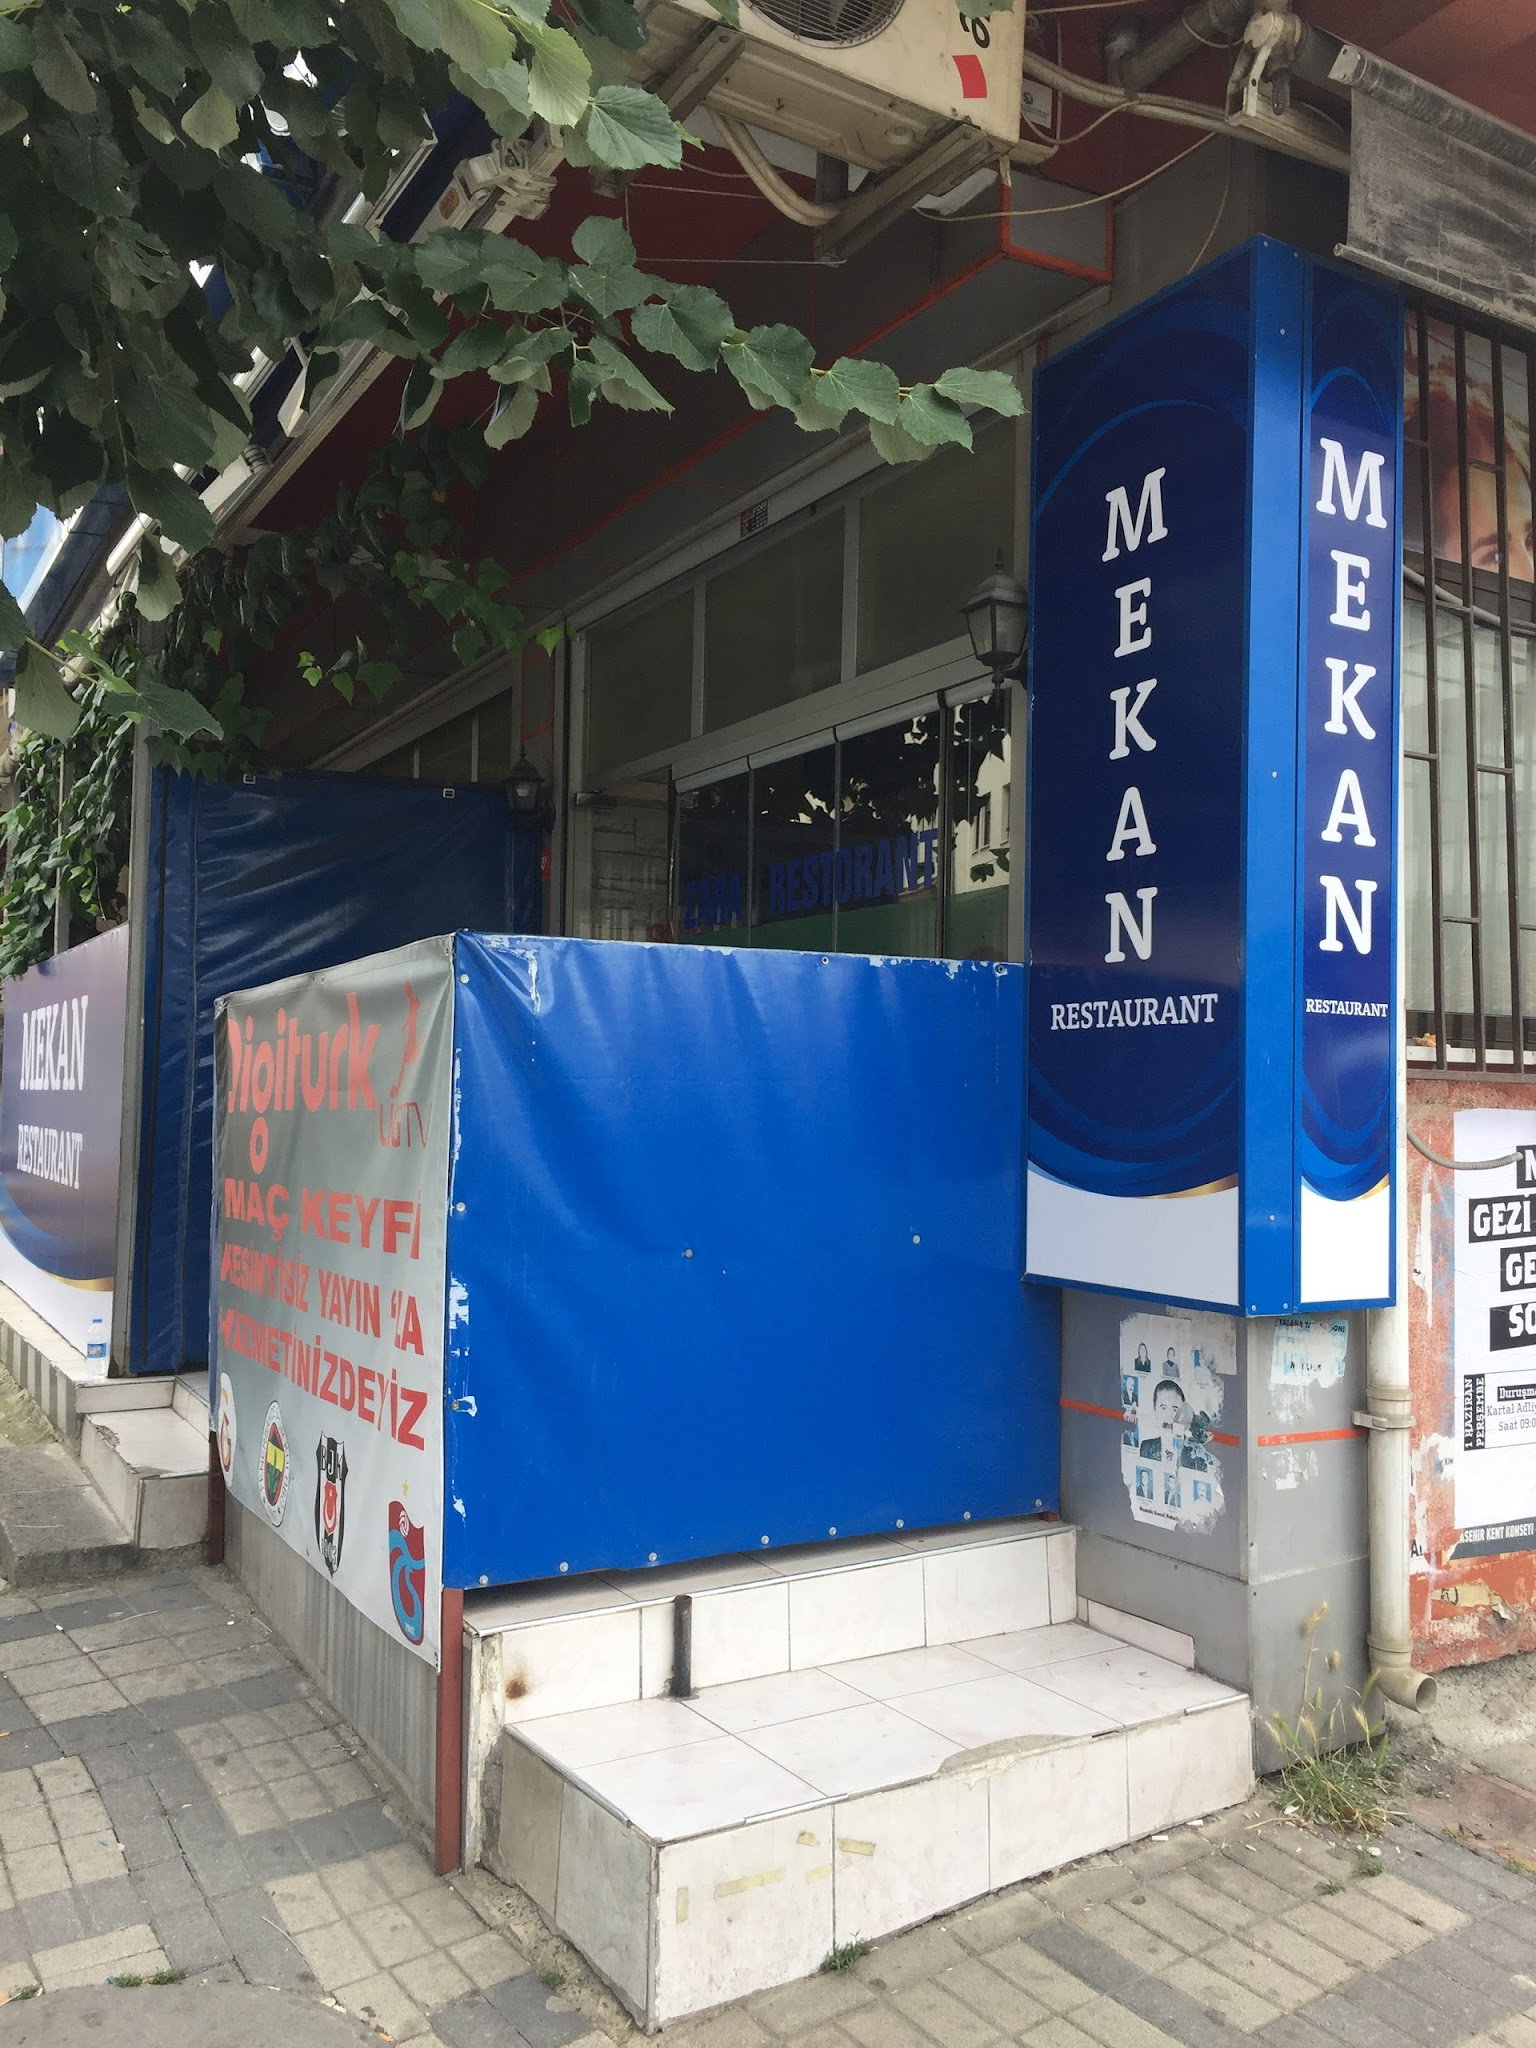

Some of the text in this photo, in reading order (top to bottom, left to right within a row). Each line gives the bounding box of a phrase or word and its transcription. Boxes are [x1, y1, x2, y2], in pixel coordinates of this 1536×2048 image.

[1102, 466, 1169, 964] MEKAN
[1316, 437, 1388, 956] MEKAN
[1050, 993, 1219, 1031] RESTAURANT
[1305, 998, 1388, 1018] RESTAURANT
[20, 995, 89, 1091] MEKAN
[17, 1123, 83, 1191] RESTAURANT
[223, 1178, 290, 1241] MAÇ
[1473, 1194, 1532, 1237] GEZİ
[317, 1267, 381, 1339] YAYIN
[1487, 1403, 1515, 1417] Kartal
[1498, 1418, 1518, 1432] Saat
[1486, 1526, 1505, 1540] KENT
